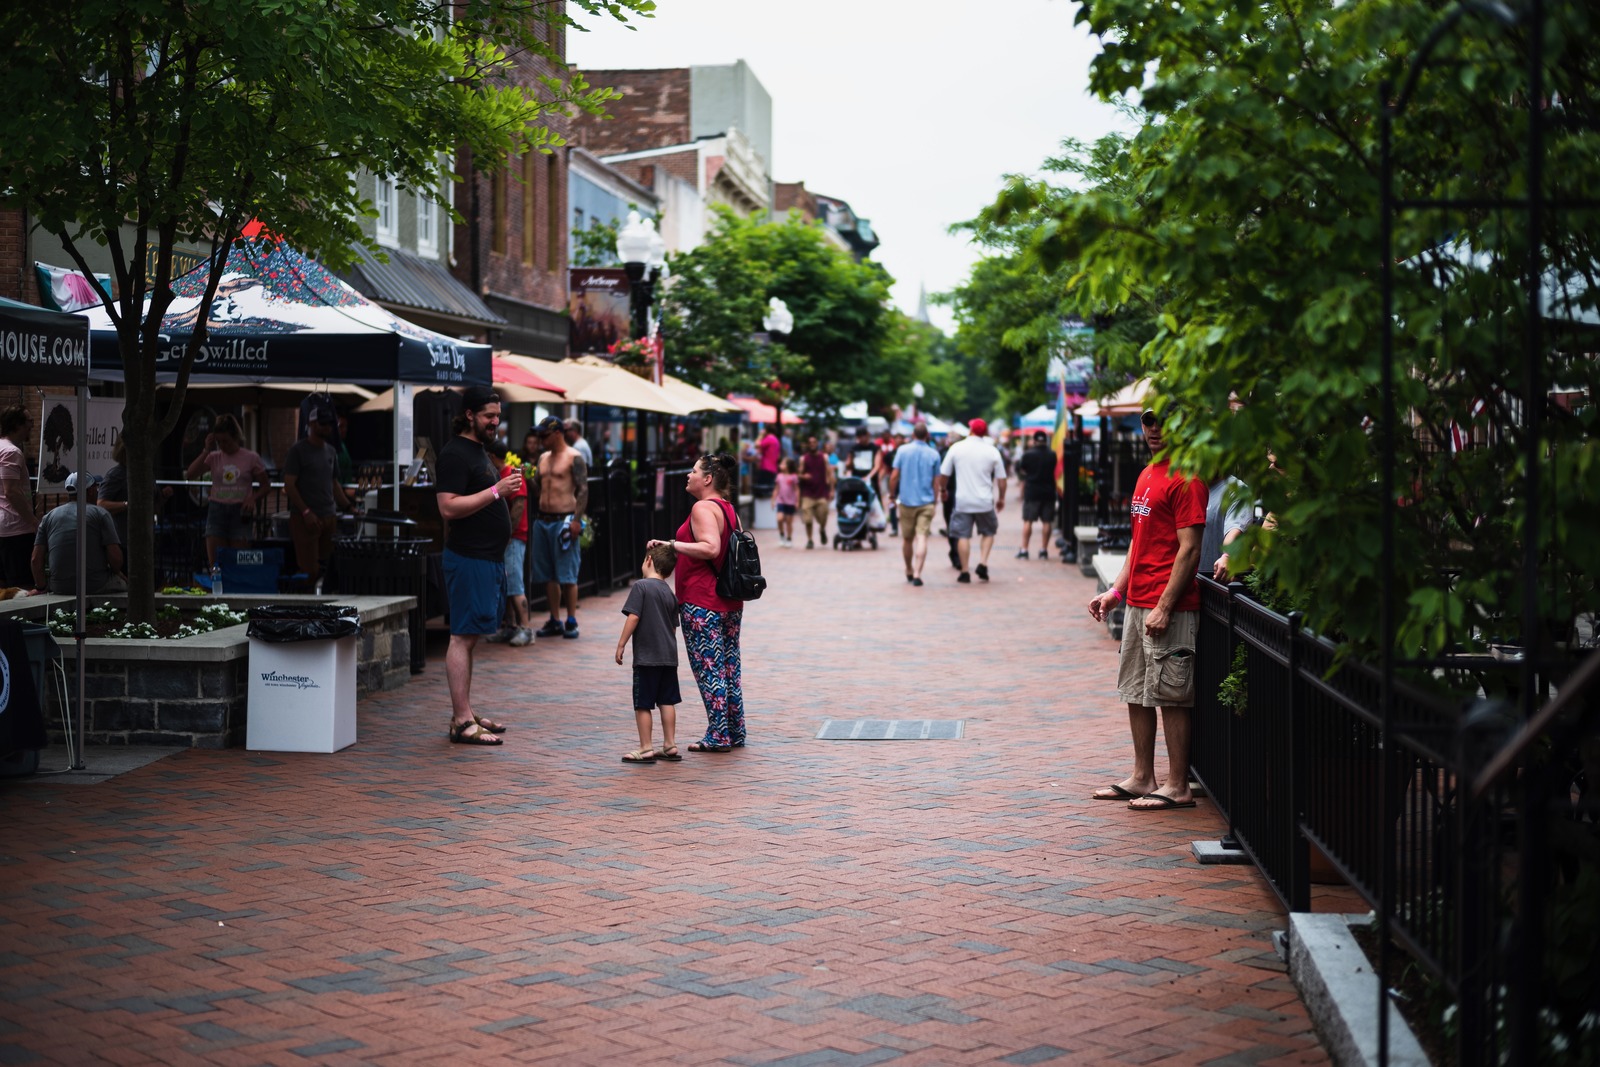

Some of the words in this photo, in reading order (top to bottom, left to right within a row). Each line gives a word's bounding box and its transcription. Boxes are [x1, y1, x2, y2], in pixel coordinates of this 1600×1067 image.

[86, 427, 106, 445] illed
[88, 451, 101, 460] ARD
[261, 671, 309, 682] Winchester
